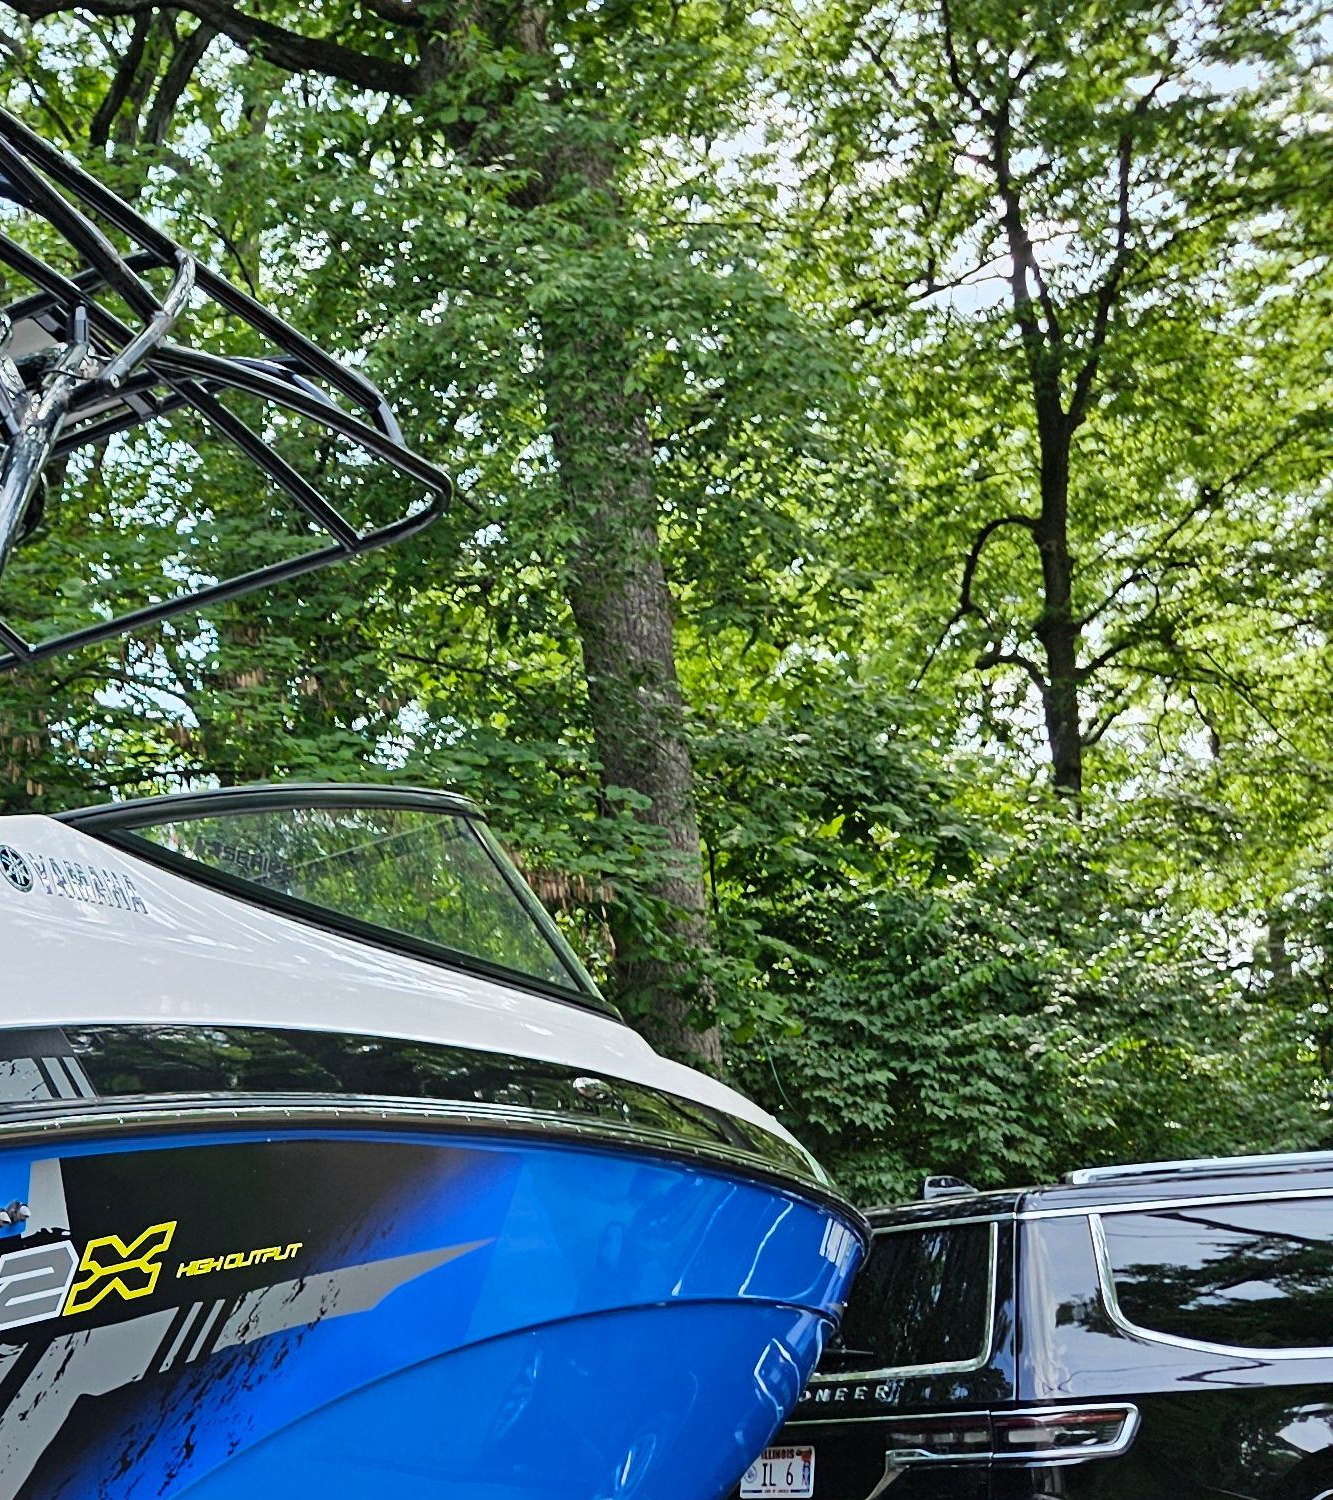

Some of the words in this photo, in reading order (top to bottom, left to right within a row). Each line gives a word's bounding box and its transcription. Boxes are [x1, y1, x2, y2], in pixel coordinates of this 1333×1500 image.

[28, 851, 149, 915] YAMAHA
[175, 1255, 225, 1279] HIGH
[223, 1242, 303, 1270] OUTPUT
[761, 1462, 777, 1487] IL
[786, 1461, 794, 1486] 6
